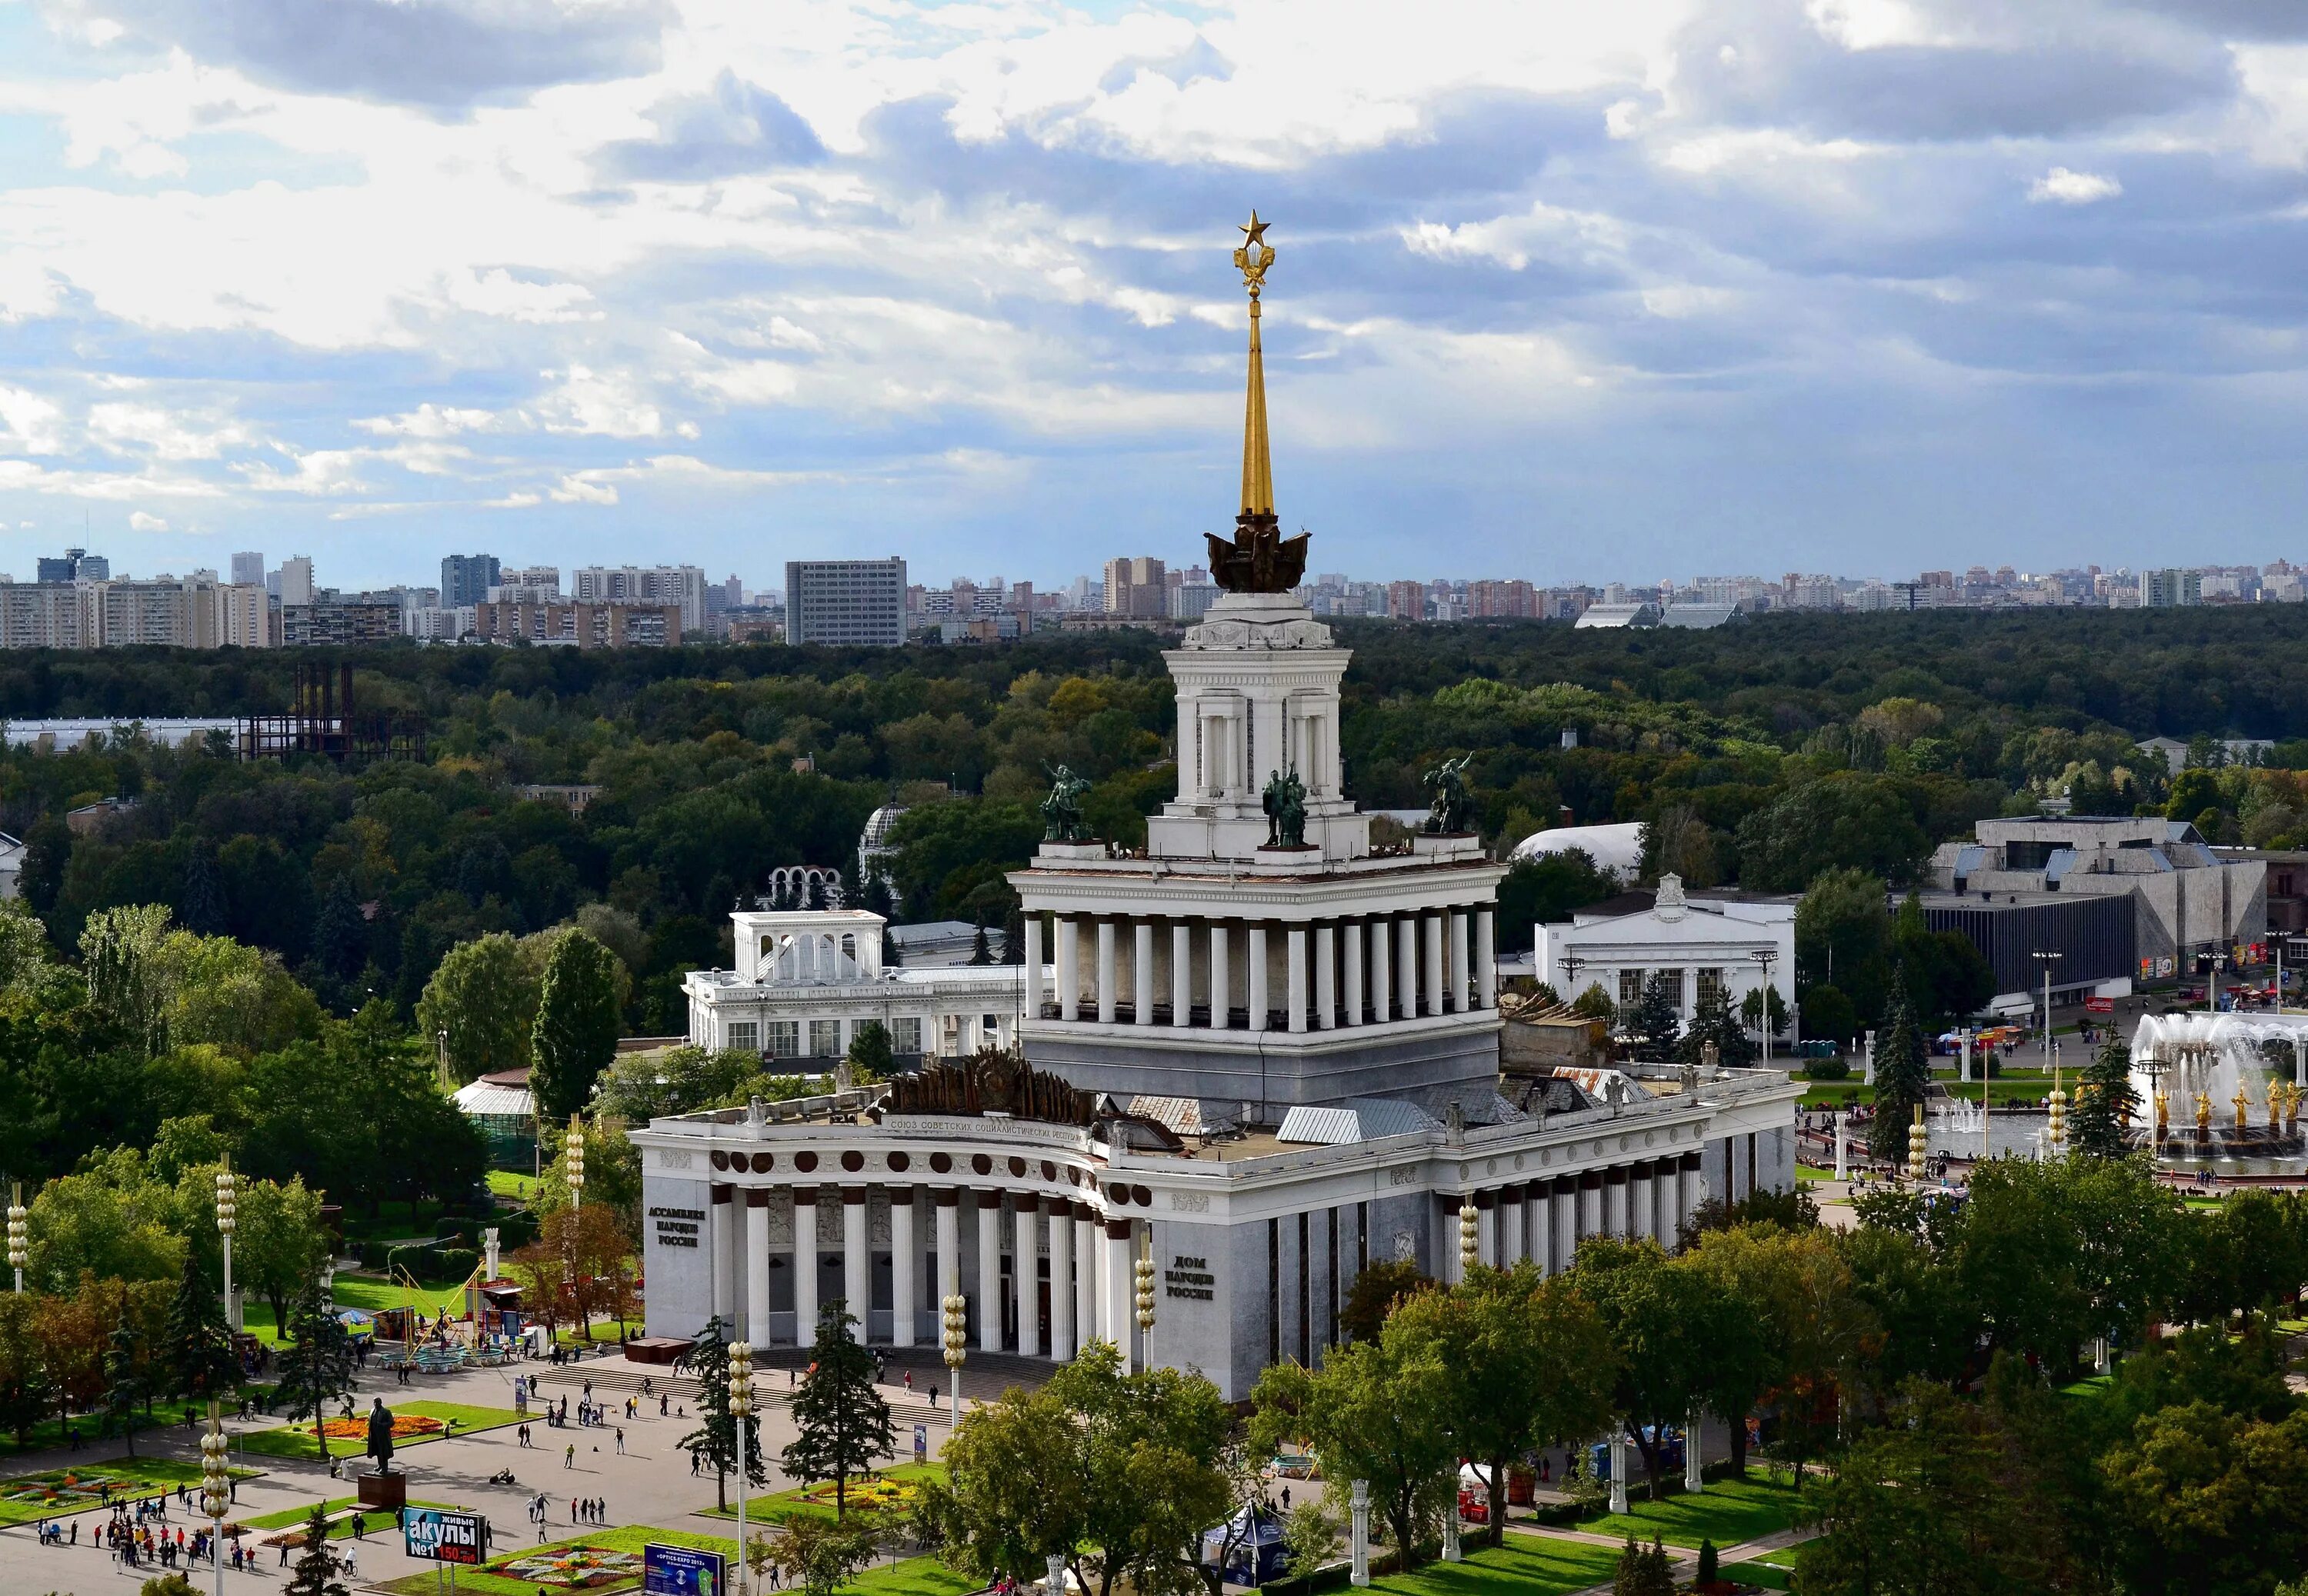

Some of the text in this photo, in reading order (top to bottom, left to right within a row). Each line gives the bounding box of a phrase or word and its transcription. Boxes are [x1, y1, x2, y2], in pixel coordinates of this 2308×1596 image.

[890, 1121, 918, 1129] СОЮЗ
[921, 1121, 972, 1131] СОВЕТСКИХ
[649, 1207, 705, 1221] АССАМБЛЕЯ
[656, 1221, 699, 1234] НАРОДОВ
[658, 1234, 698, 1248] РОССИИ
[1173, 1255, 1207, 1269] ДОМ
[1164, 1270, 1215, 1285] НАРОДОВ
[1166, 1285, 1213, 1301] РОССИИ
[442, 1515, 475, 1526] живые
[409, 1520, 475, 1548] акулы
[411, 1541, 435, 1558] №1
